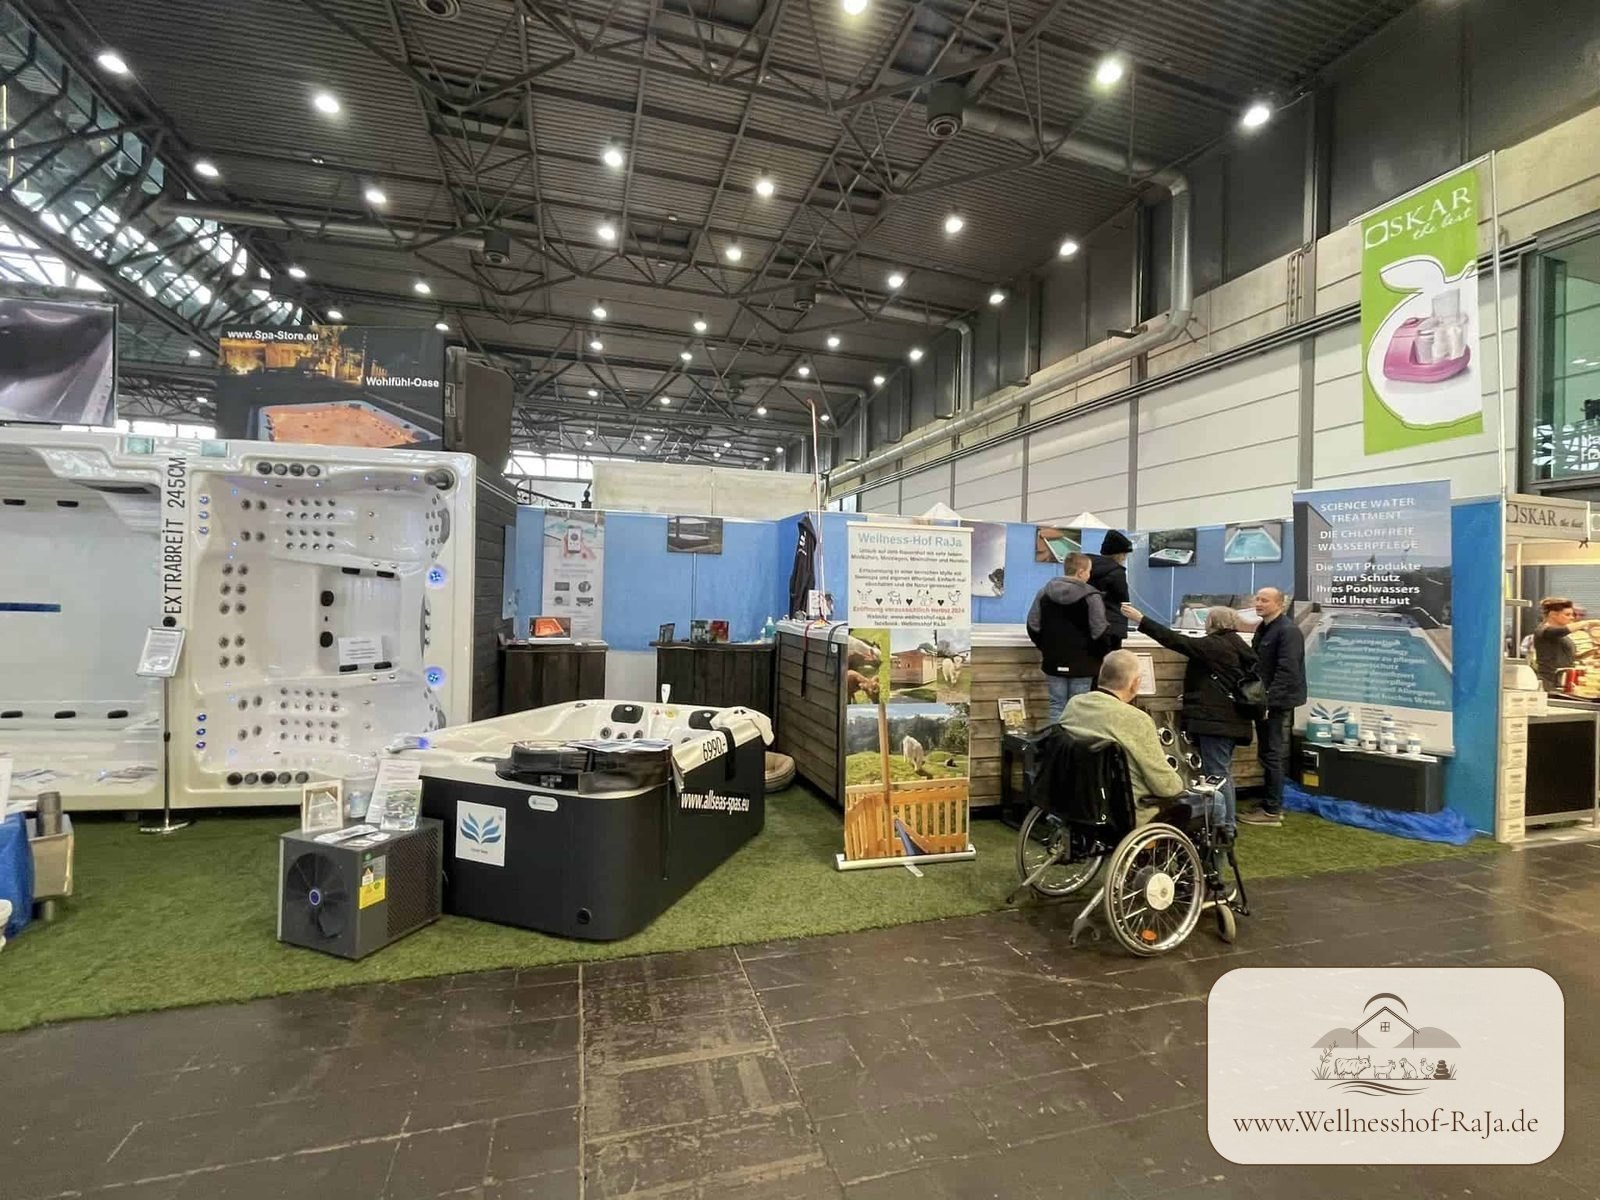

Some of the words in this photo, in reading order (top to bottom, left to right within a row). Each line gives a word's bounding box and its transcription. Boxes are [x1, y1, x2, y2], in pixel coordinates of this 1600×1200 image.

[1365, 187, 1472, 249] OSKAR
[227, 330, 319, 341] www.Spa-Store.eu
[366, 376, 439, 388] Wohlfühl-Oase
[1320, 501, 1368, 512] SCIENCE
[1370, 497, 1415, 508] WATER
[1331, 511, 1401, 523] TREATMENT
[1506, 504, 1557, 526] OSKAR
[858, 532, 932, 546] Wellness-Hof
[935, 536, 963, 547] RaJa
[1320, 530, 1338, 539] DIE
[1316, 563, 1334, 571] Die
[1336, 563, 1360, 571] SWT
[1364, 562, 1421, 571] Produkte
[1360, 573, 1401, 582] Schutz
[1316, 585, 1344, 593] Ihres
[1346, 585, 1421, 594] Poolwassers
[1325, 596, 1346, 604] und
[1350, 596, 1378, 604] Ihrer
[1380, 596, 1410, 605] Haut
[680, 789, 750, 815] www.allseas-spas.eu
